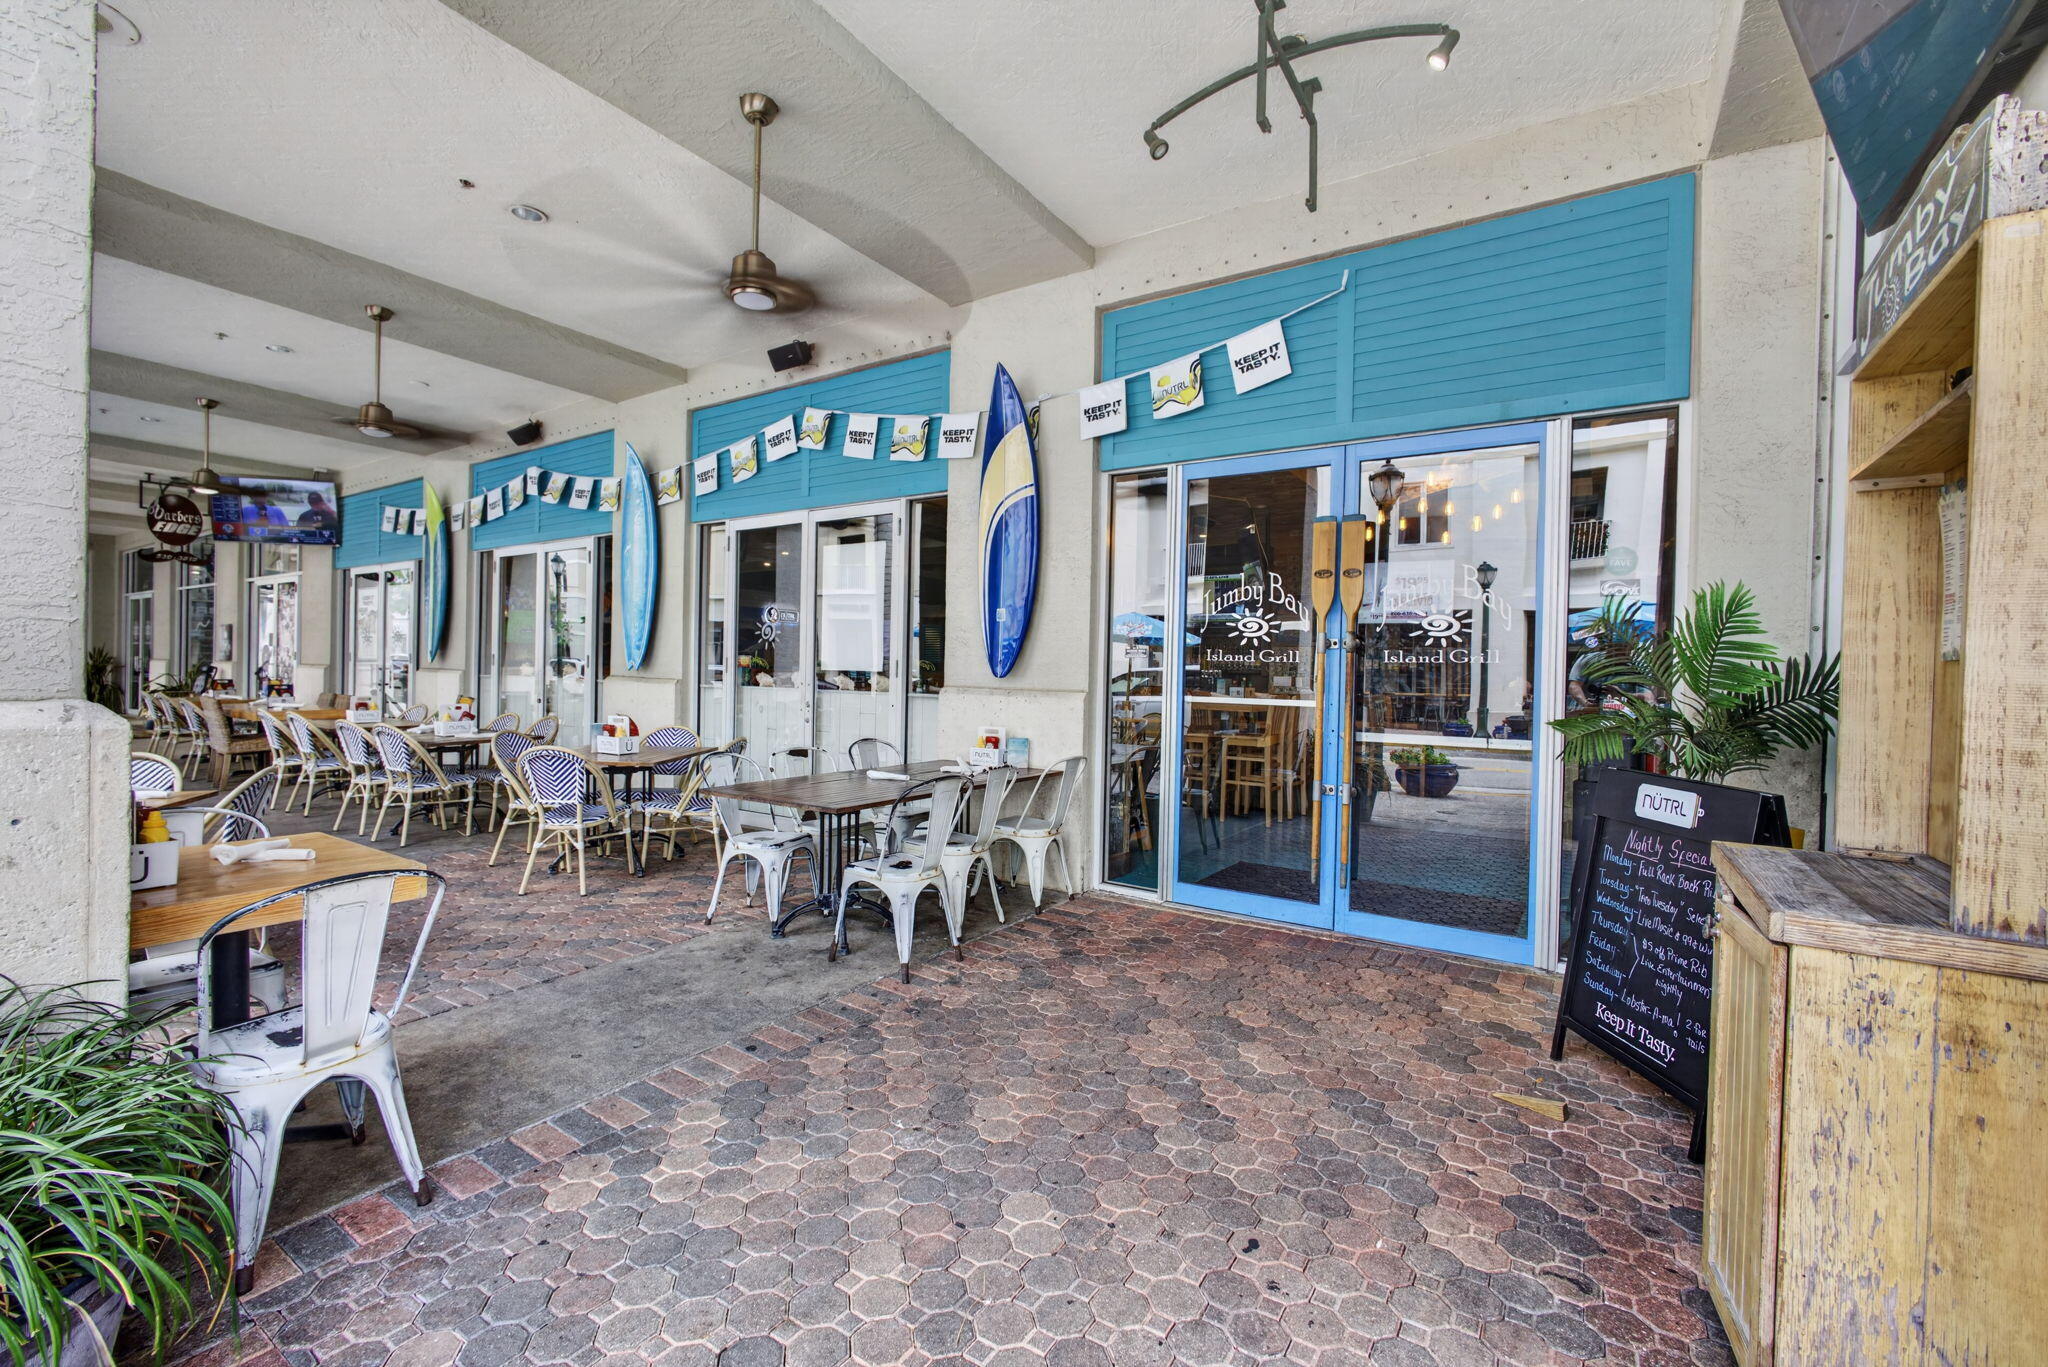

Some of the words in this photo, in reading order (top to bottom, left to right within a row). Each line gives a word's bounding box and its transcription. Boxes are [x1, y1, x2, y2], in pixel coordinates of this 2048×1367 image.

[1903, 182, 1976, 297] Bay
[1859, 163, 1958, 358] Jumby
[1234, 348, 1267, 368] KEEP
[1269, 342, 1281, 353] IT
[1238, 351, 1281, 375] TASTY.
[1083, 402, 1112, 416] KEEP
[1112, 399, 1122, 409] IT
[767, 432, 785, 444] KEEP
[784, 428, 792, 437] IT
[848, 429, 867, 438] KEEP
[867, 431, 875, 439] IT
[942, 428, 965, 437] KEEP
[965, 428, 975, 437] IT
[944, 435, 972, 444] TASTY.
[696, 468, 711, 480] KEEP
[152, 520, 201, 536] EDGE
[1200, 572, 1264, 633] Jumby
[1268, 571, 1311, 632] Bay
[1462, 564, 1512, 631] Bay
[1206, 648, 1256, 663] Island
[1259, 649, 1301, 664] Grill
[1383, 649, 1445, 664] Island
[1449, 649, 1501, 664] Grill
[1623, 828, 1664, 861] Nightly
[1638, 860, 1655, 878] Full
[1636, 908, 1652, 929] Live
[1640, 954, 1656, 972] Live
[1666, 946, 1689, 969] Prime
[1690, 957, 1708, 979] Rib
[1595, 1001, 1625, 1034] Keep
[1625, 1018, 1637, 1039] It
[1638, 1024, 1676, 1062] Tasty.
[1685, 1018, 1693, 1031] 2
